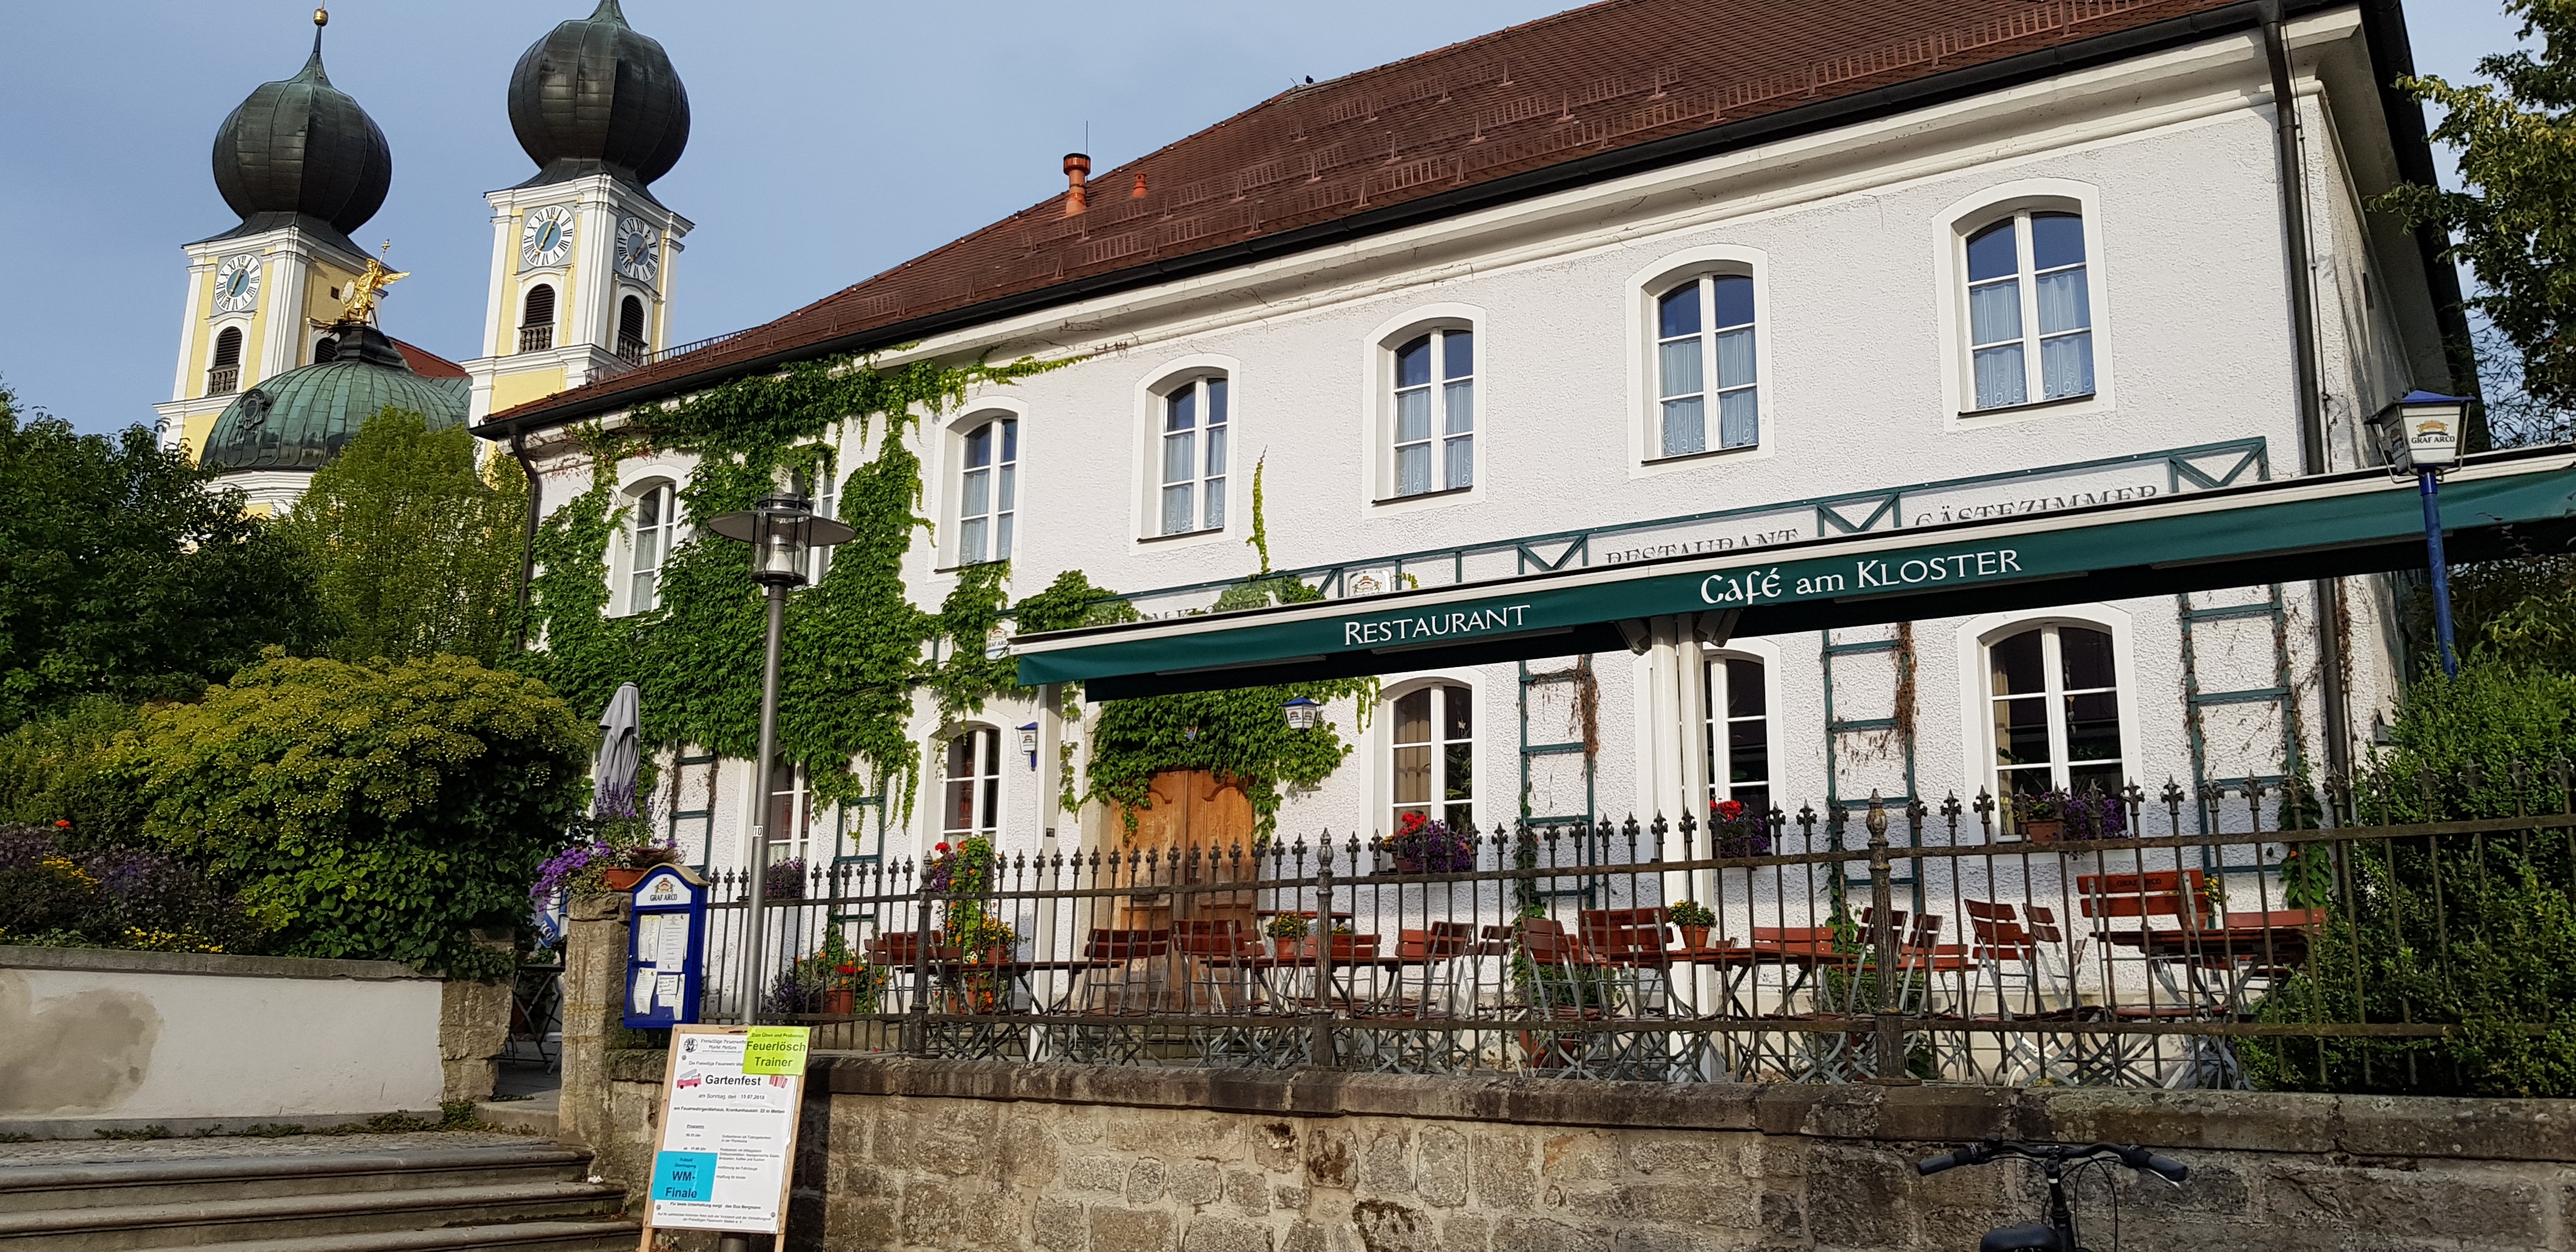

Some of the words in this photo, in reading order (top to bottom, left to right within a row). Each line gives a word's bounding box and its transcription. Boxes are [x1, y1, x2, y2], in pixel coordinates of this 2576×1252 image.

[1701, 567, 1782, 605] Café
[1795, 573, 1845, 595] am
[746, 1041, 806, 1051] Feuerlösch
[755, 1057, 793, 1067] Trainer
[705, 1074, 762, 1086] Gartenfest
[665, 1187, 698, 1198] Finale
